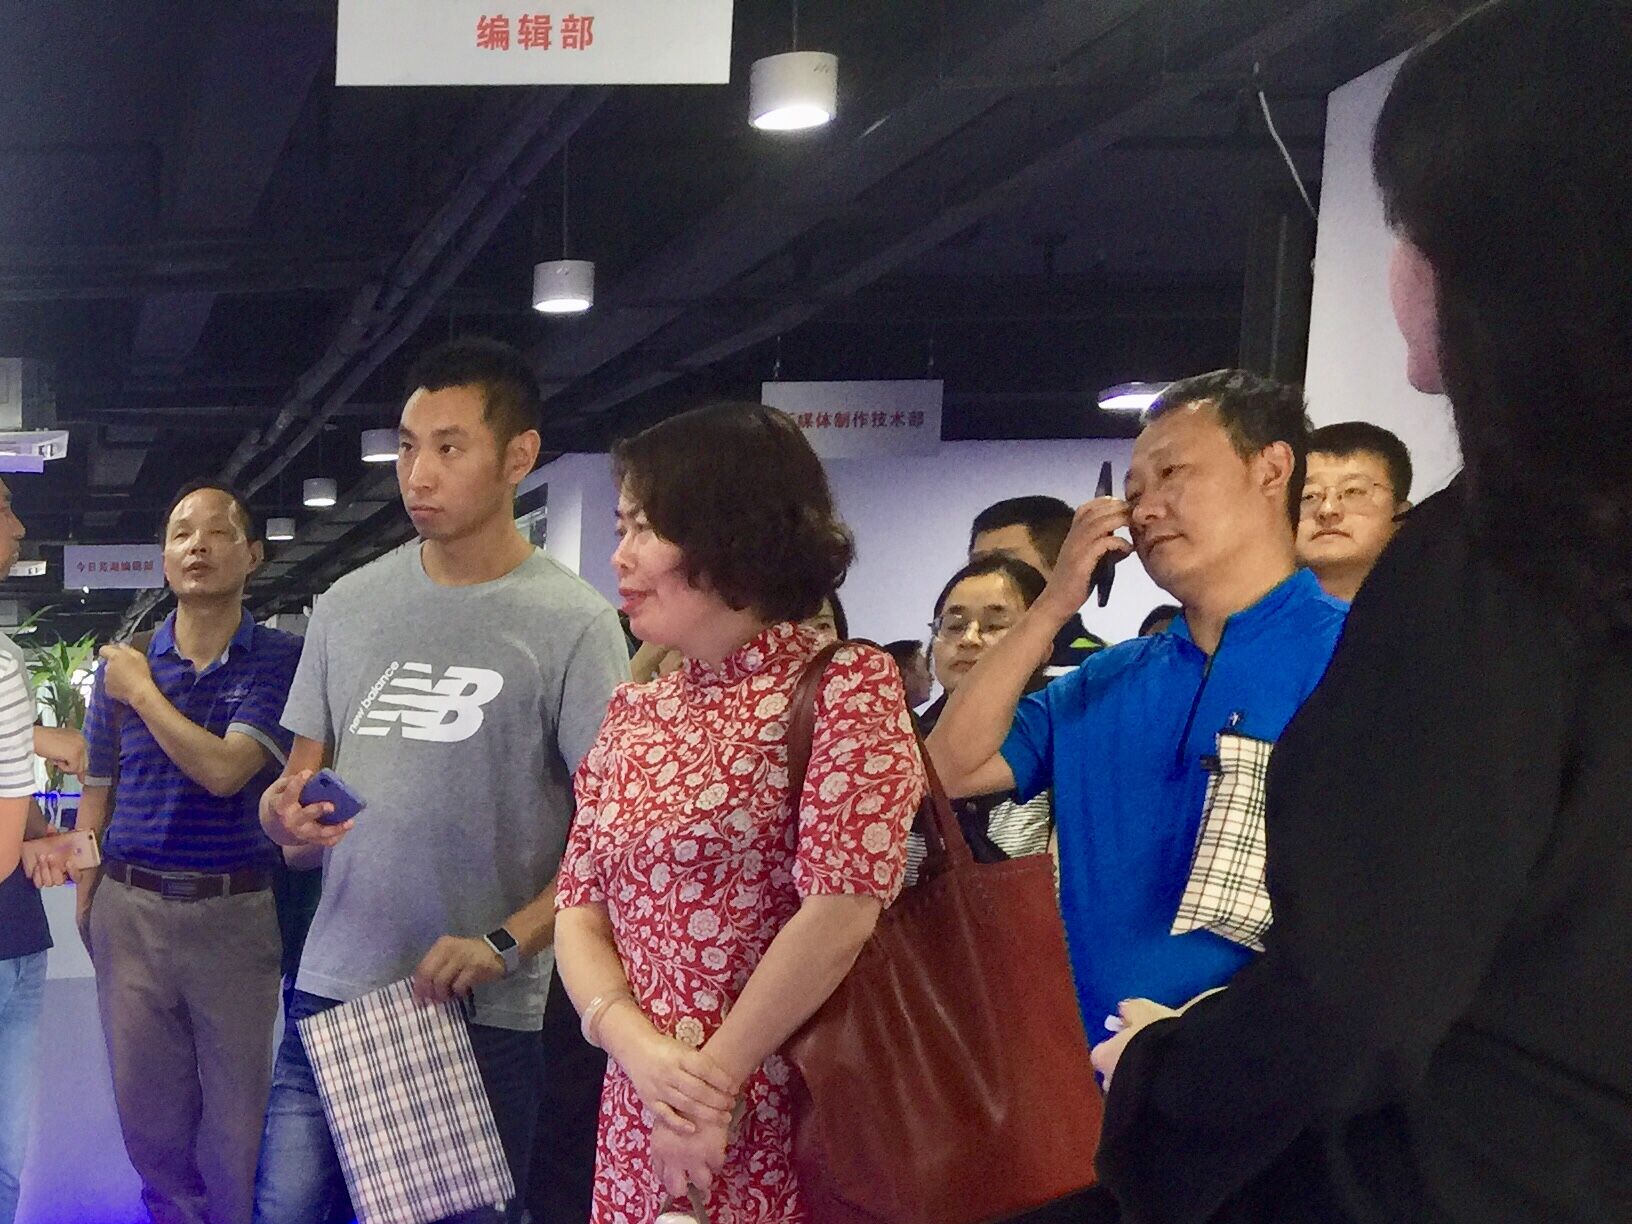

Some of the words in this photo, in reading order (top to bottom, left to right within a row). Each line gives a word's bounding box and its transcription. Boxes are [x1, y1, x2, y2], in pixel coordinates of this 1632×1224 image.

[476, 14, 595, 51] 编辑部
[789, 411, 925, 429] 媒体制作技术部
[349, 707, 365, 735] new
[361, 660, 400, 709] balance
